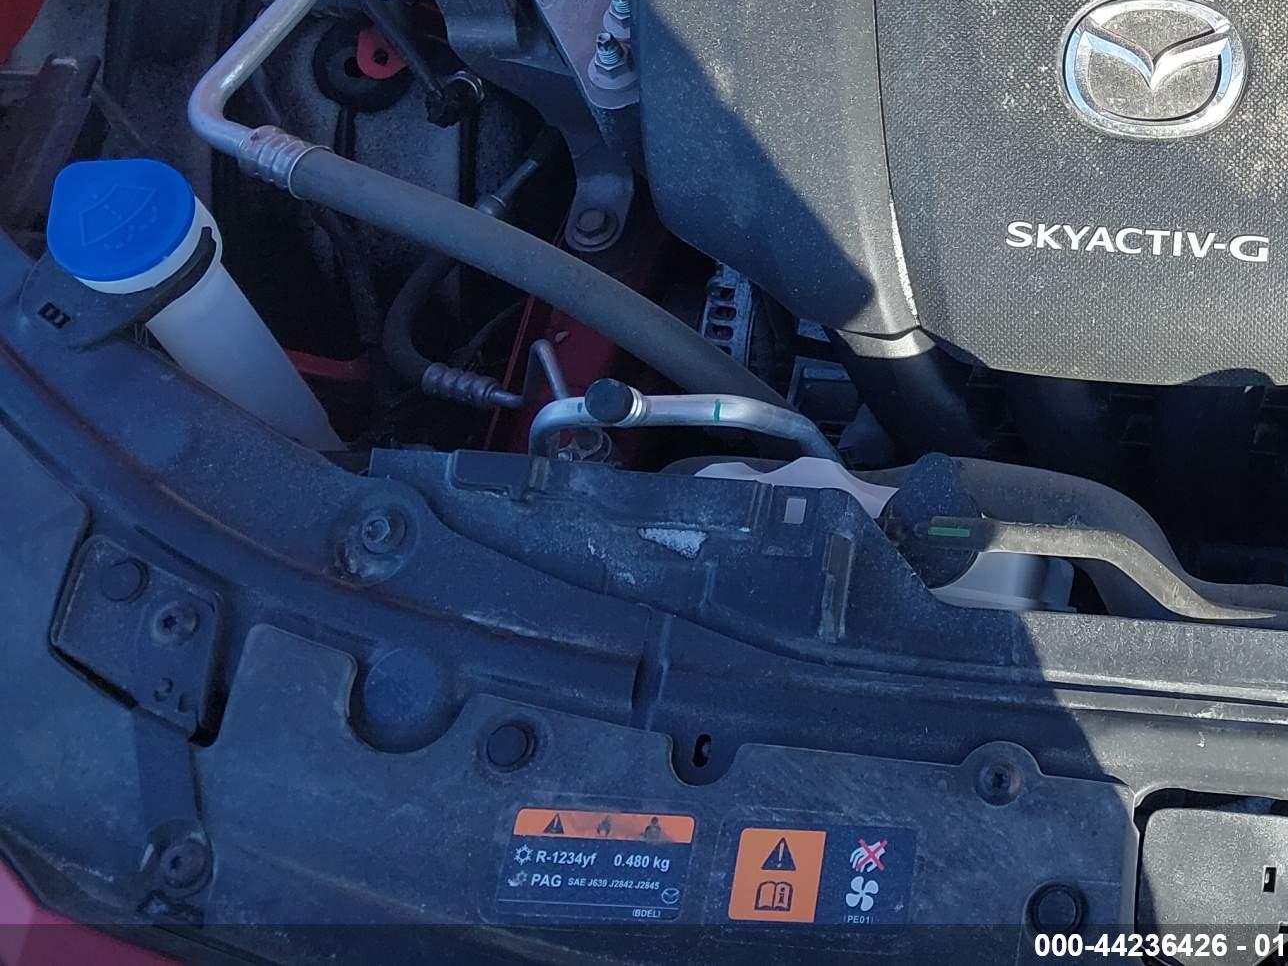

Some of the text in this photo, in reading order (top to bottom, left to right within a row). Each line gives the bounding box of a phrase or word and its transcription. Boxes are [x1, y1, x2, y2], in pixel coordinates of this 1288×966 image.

[1005, 221, 1270, 263] SKYACTIV-G
[535, 850, 670, 872] R-1234yf 0.480 kg
[531, 874, 562, 887] PAG
[568, 877, 586, 887] SAE
